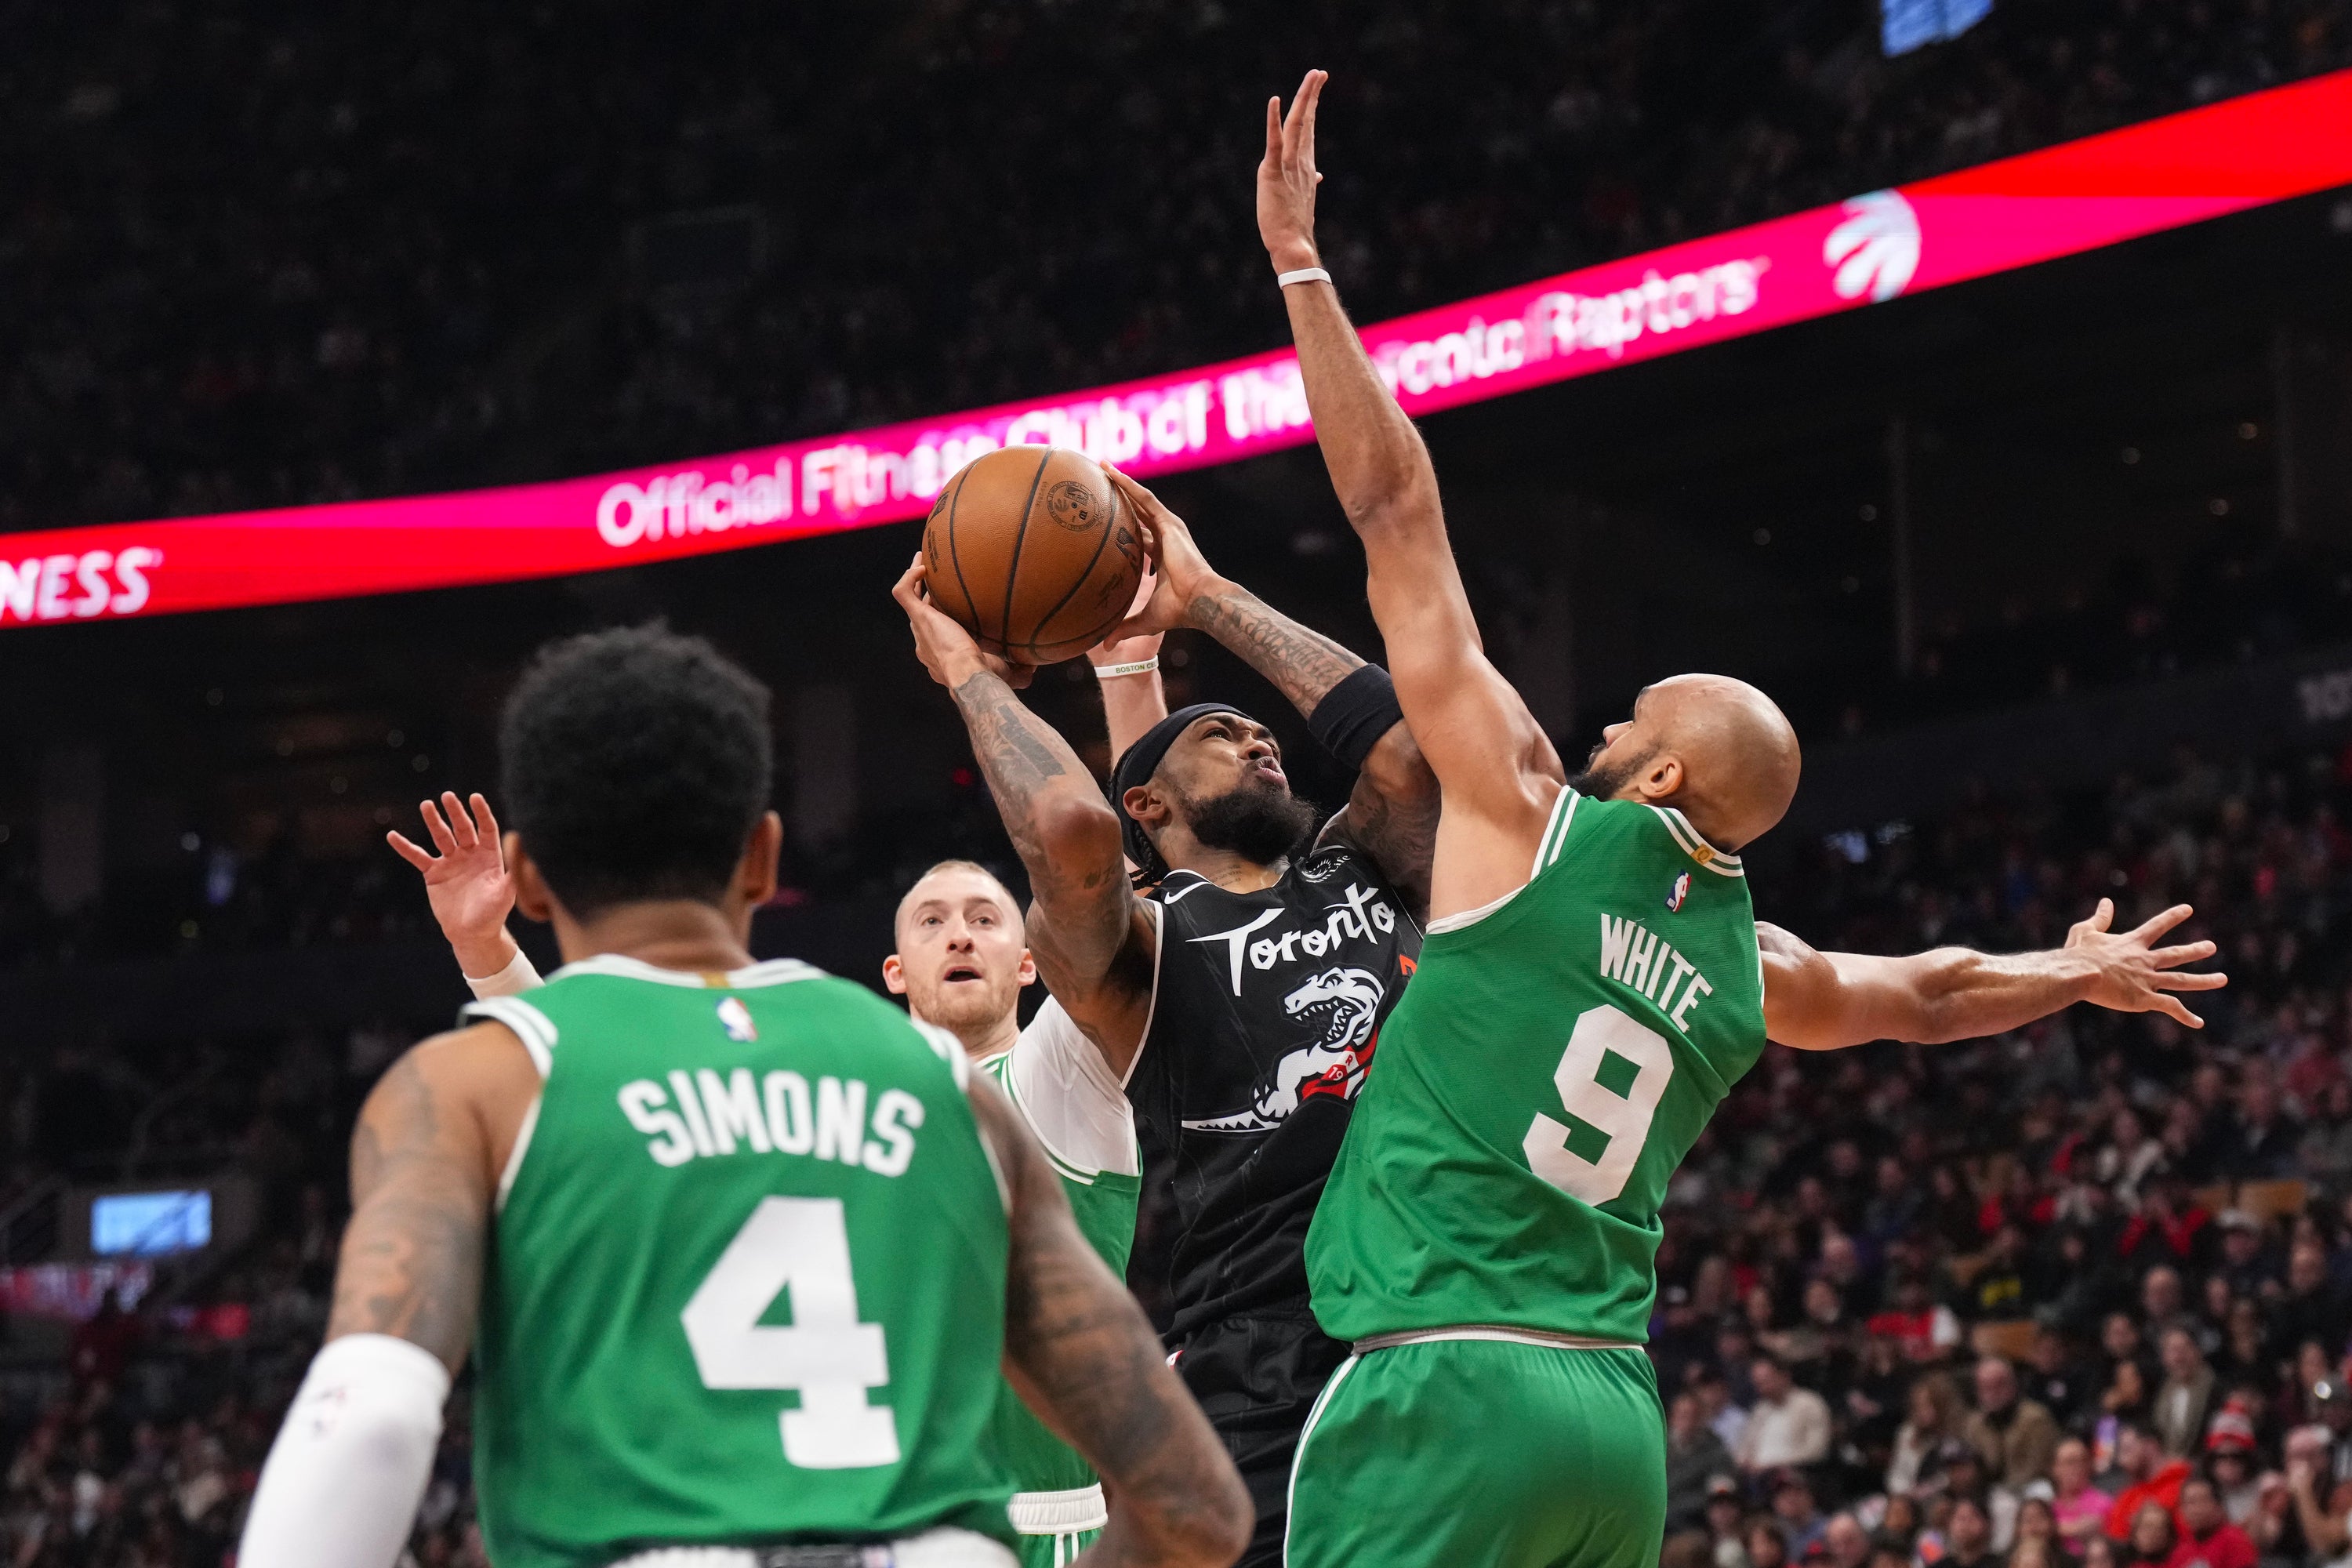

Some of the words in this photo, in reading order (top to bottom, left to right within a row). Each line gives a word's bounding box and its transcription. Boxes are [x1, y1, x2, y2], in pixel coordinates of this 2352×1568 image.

[596, 456, 793, 548] Official
[1526, 260, 1758, 358] Raptors
[0, 546, 154, 621] NESS
[1116, 664, 1145, 673] BOSTON
[1185, 882, 1396, 996] Toronto
[1600, 913, 1714, 1033] WHITE
[617, 1069, 925, 1178] SIMONS
[1329, 1066, 1344, 1081] 19
[1523, 1004, 1674, 1207] 9
[681, 1196, 901, 1469] 4
